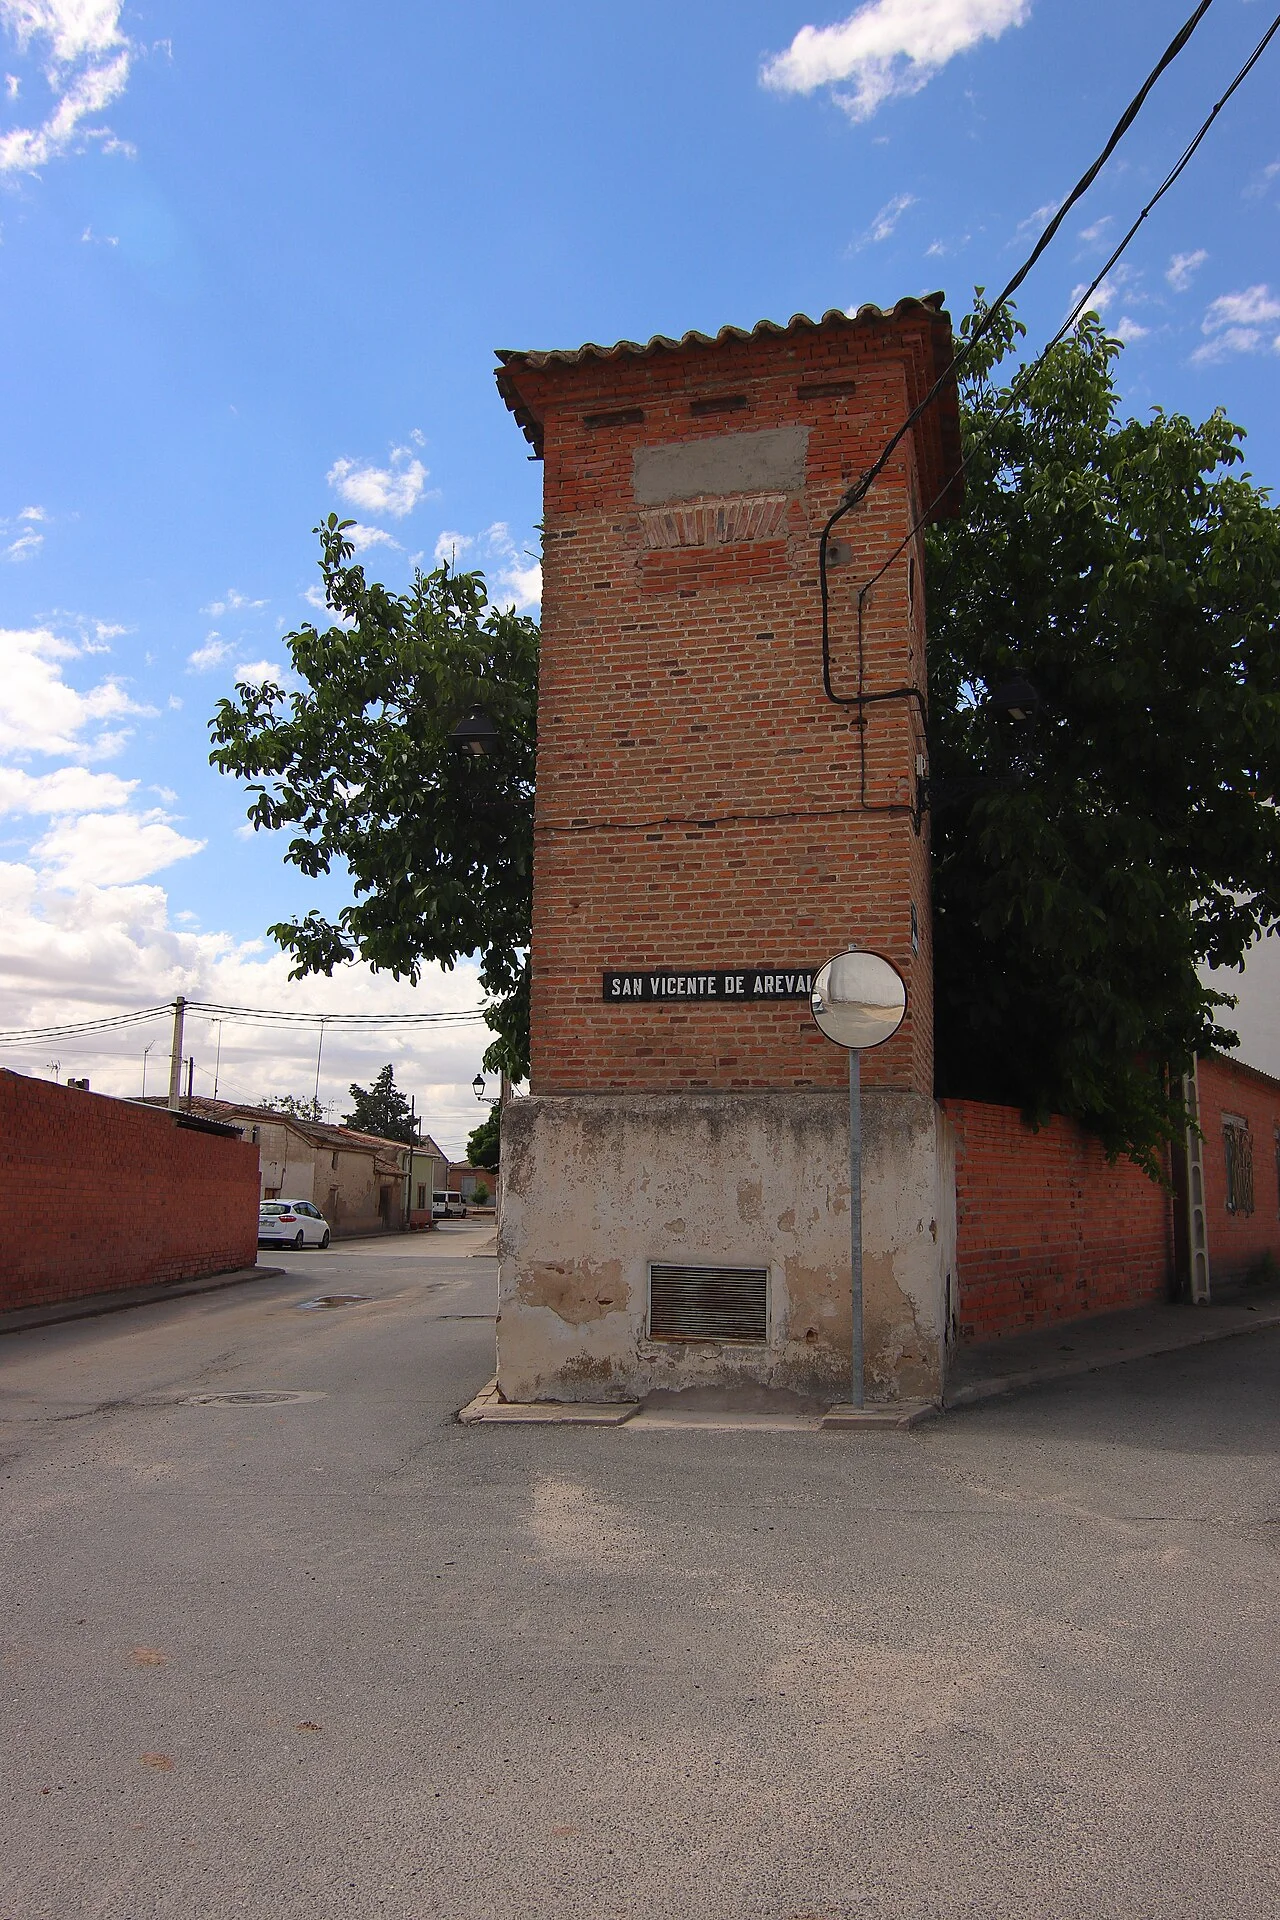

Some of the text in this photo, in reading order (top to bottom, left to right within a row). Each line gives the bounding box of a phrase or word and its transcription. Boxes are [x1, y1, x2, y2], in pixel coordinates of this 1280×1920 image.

[611, 978, 643, 996] SAN
[650, 976, 717, 995] VICENTE
[724, 976, 745, 994] DE
